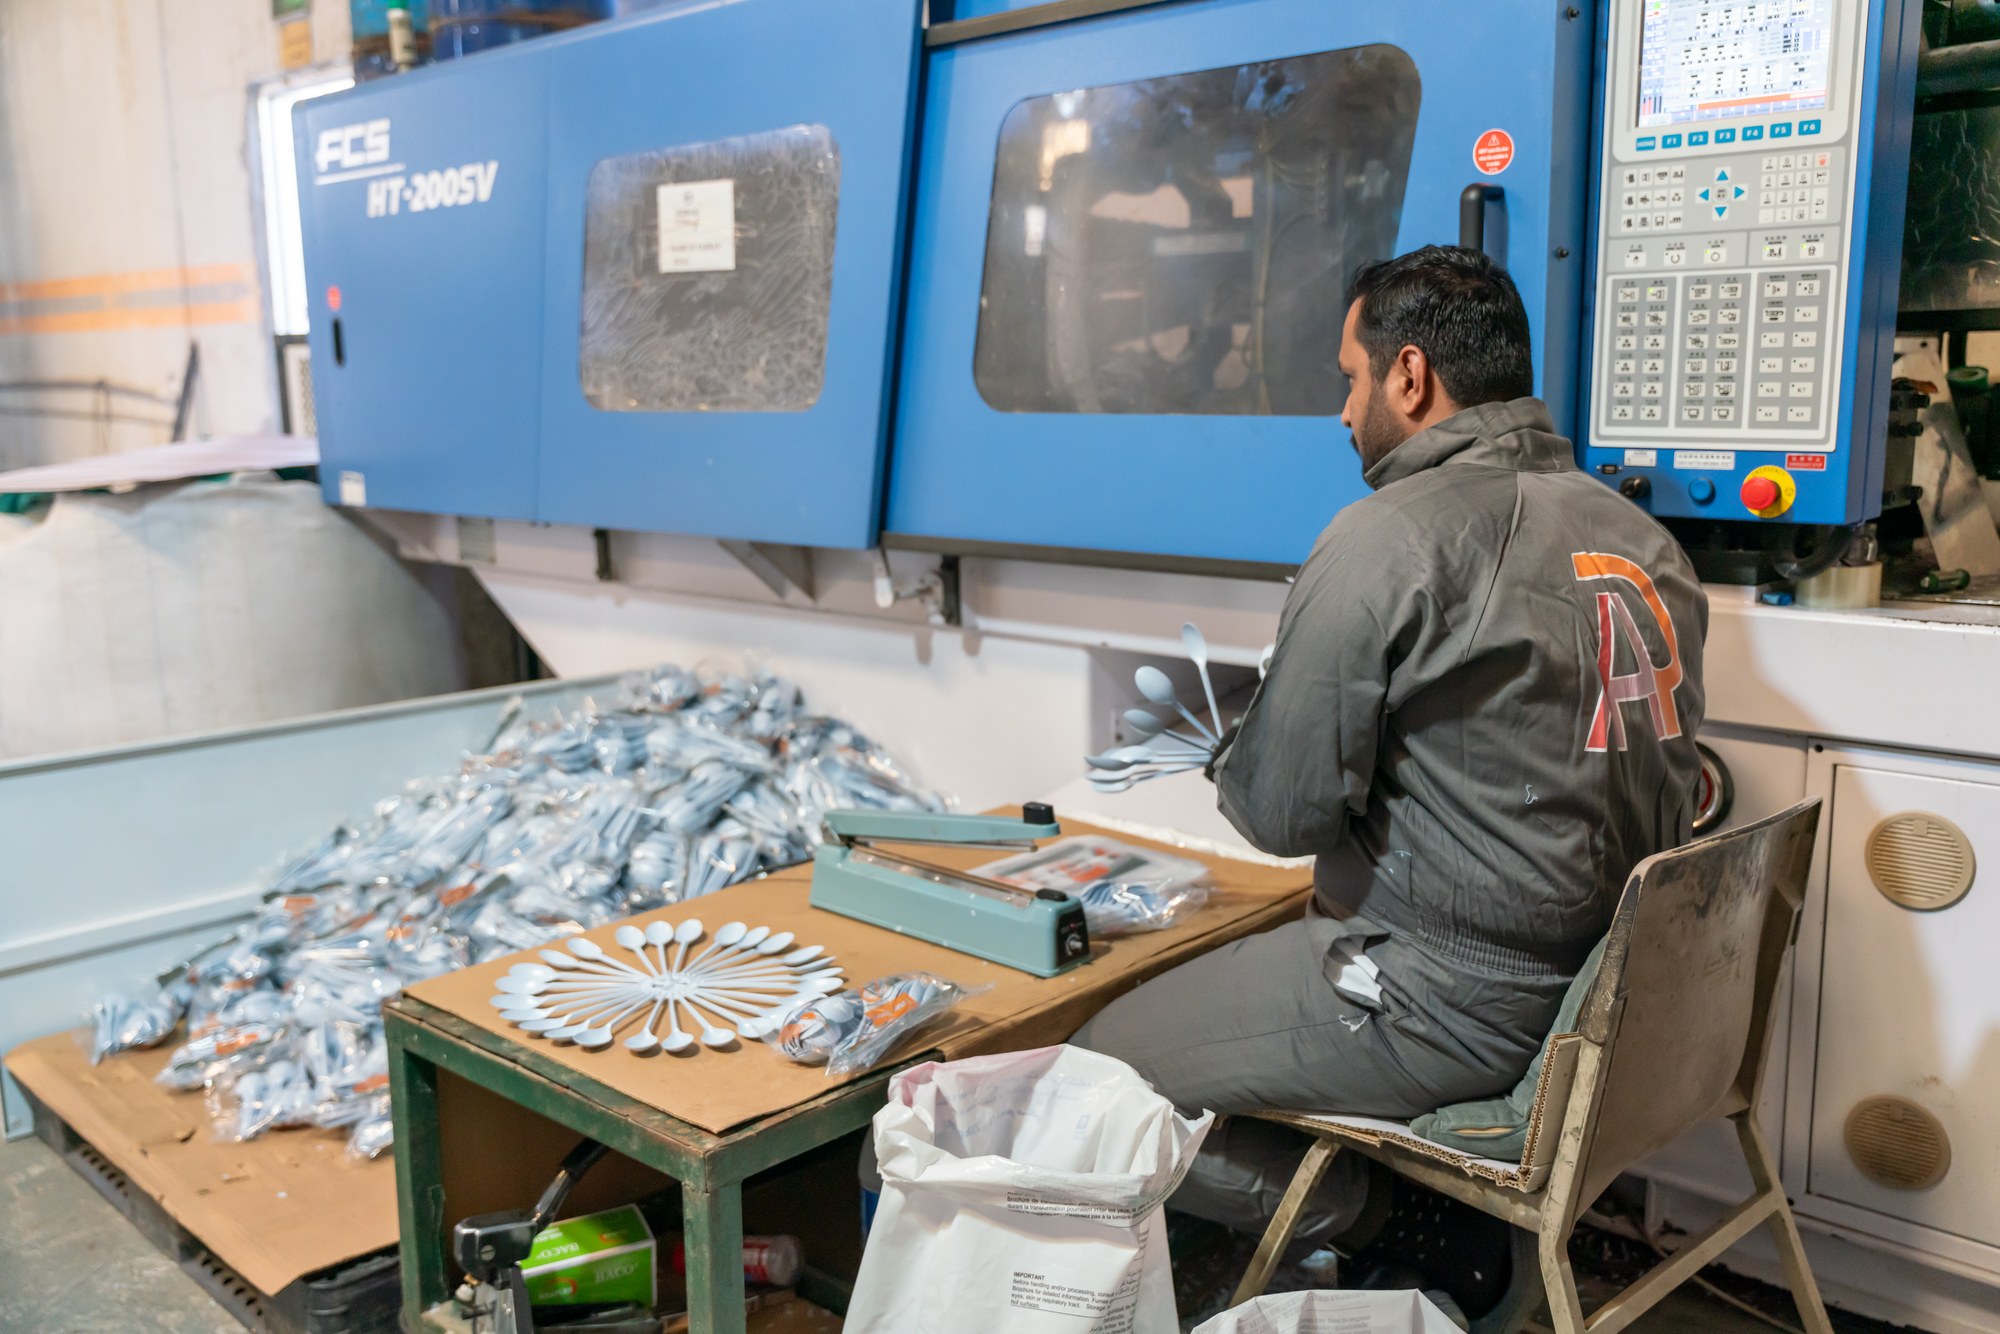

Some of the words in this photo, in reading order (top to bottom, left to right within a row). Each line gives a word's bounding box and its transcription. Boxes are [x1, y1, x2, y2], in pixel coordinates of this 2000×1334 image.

[1666, 137, 1677, 145] F1
[1692, 134, 1704, 143] F2
[1803, 123, 1816, 132] F6
[315, 117, 391, 173] FCS
[1013, 1271, 1045, 1281] IMPORTANT
[1013, 1278, 1029, 1286] Before
[1030, 1281, 1050, 1289] handling
[1042, 1290, 1061, 1298] detailed
[1061, 1293, 1090, 1302] information.
[1042, 1297, 1067, 1306] respiratory
